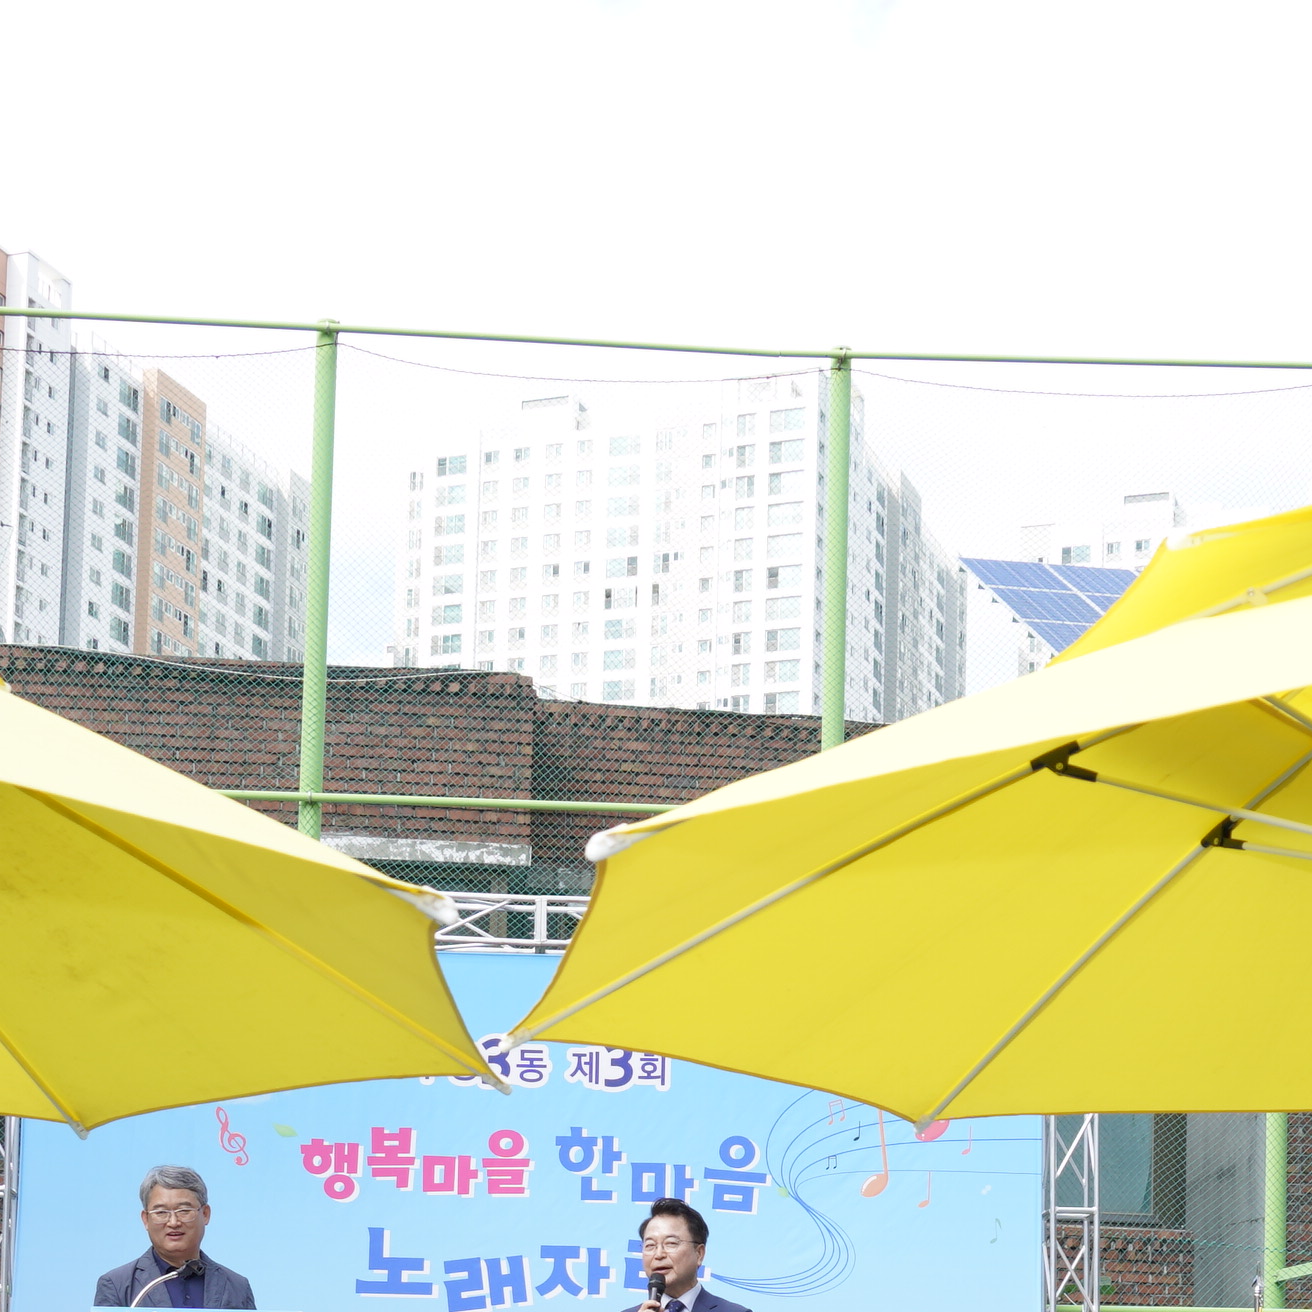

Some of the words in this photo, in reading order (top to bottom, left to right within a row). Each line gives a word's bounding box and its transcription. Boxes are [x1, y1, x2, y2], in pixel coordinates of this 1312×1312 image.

[570, 1046, 666, 1087] 제3회
[300, 1127, 531, 1200] 행복마을
[555, 1127, 769, 1212] 한마음
